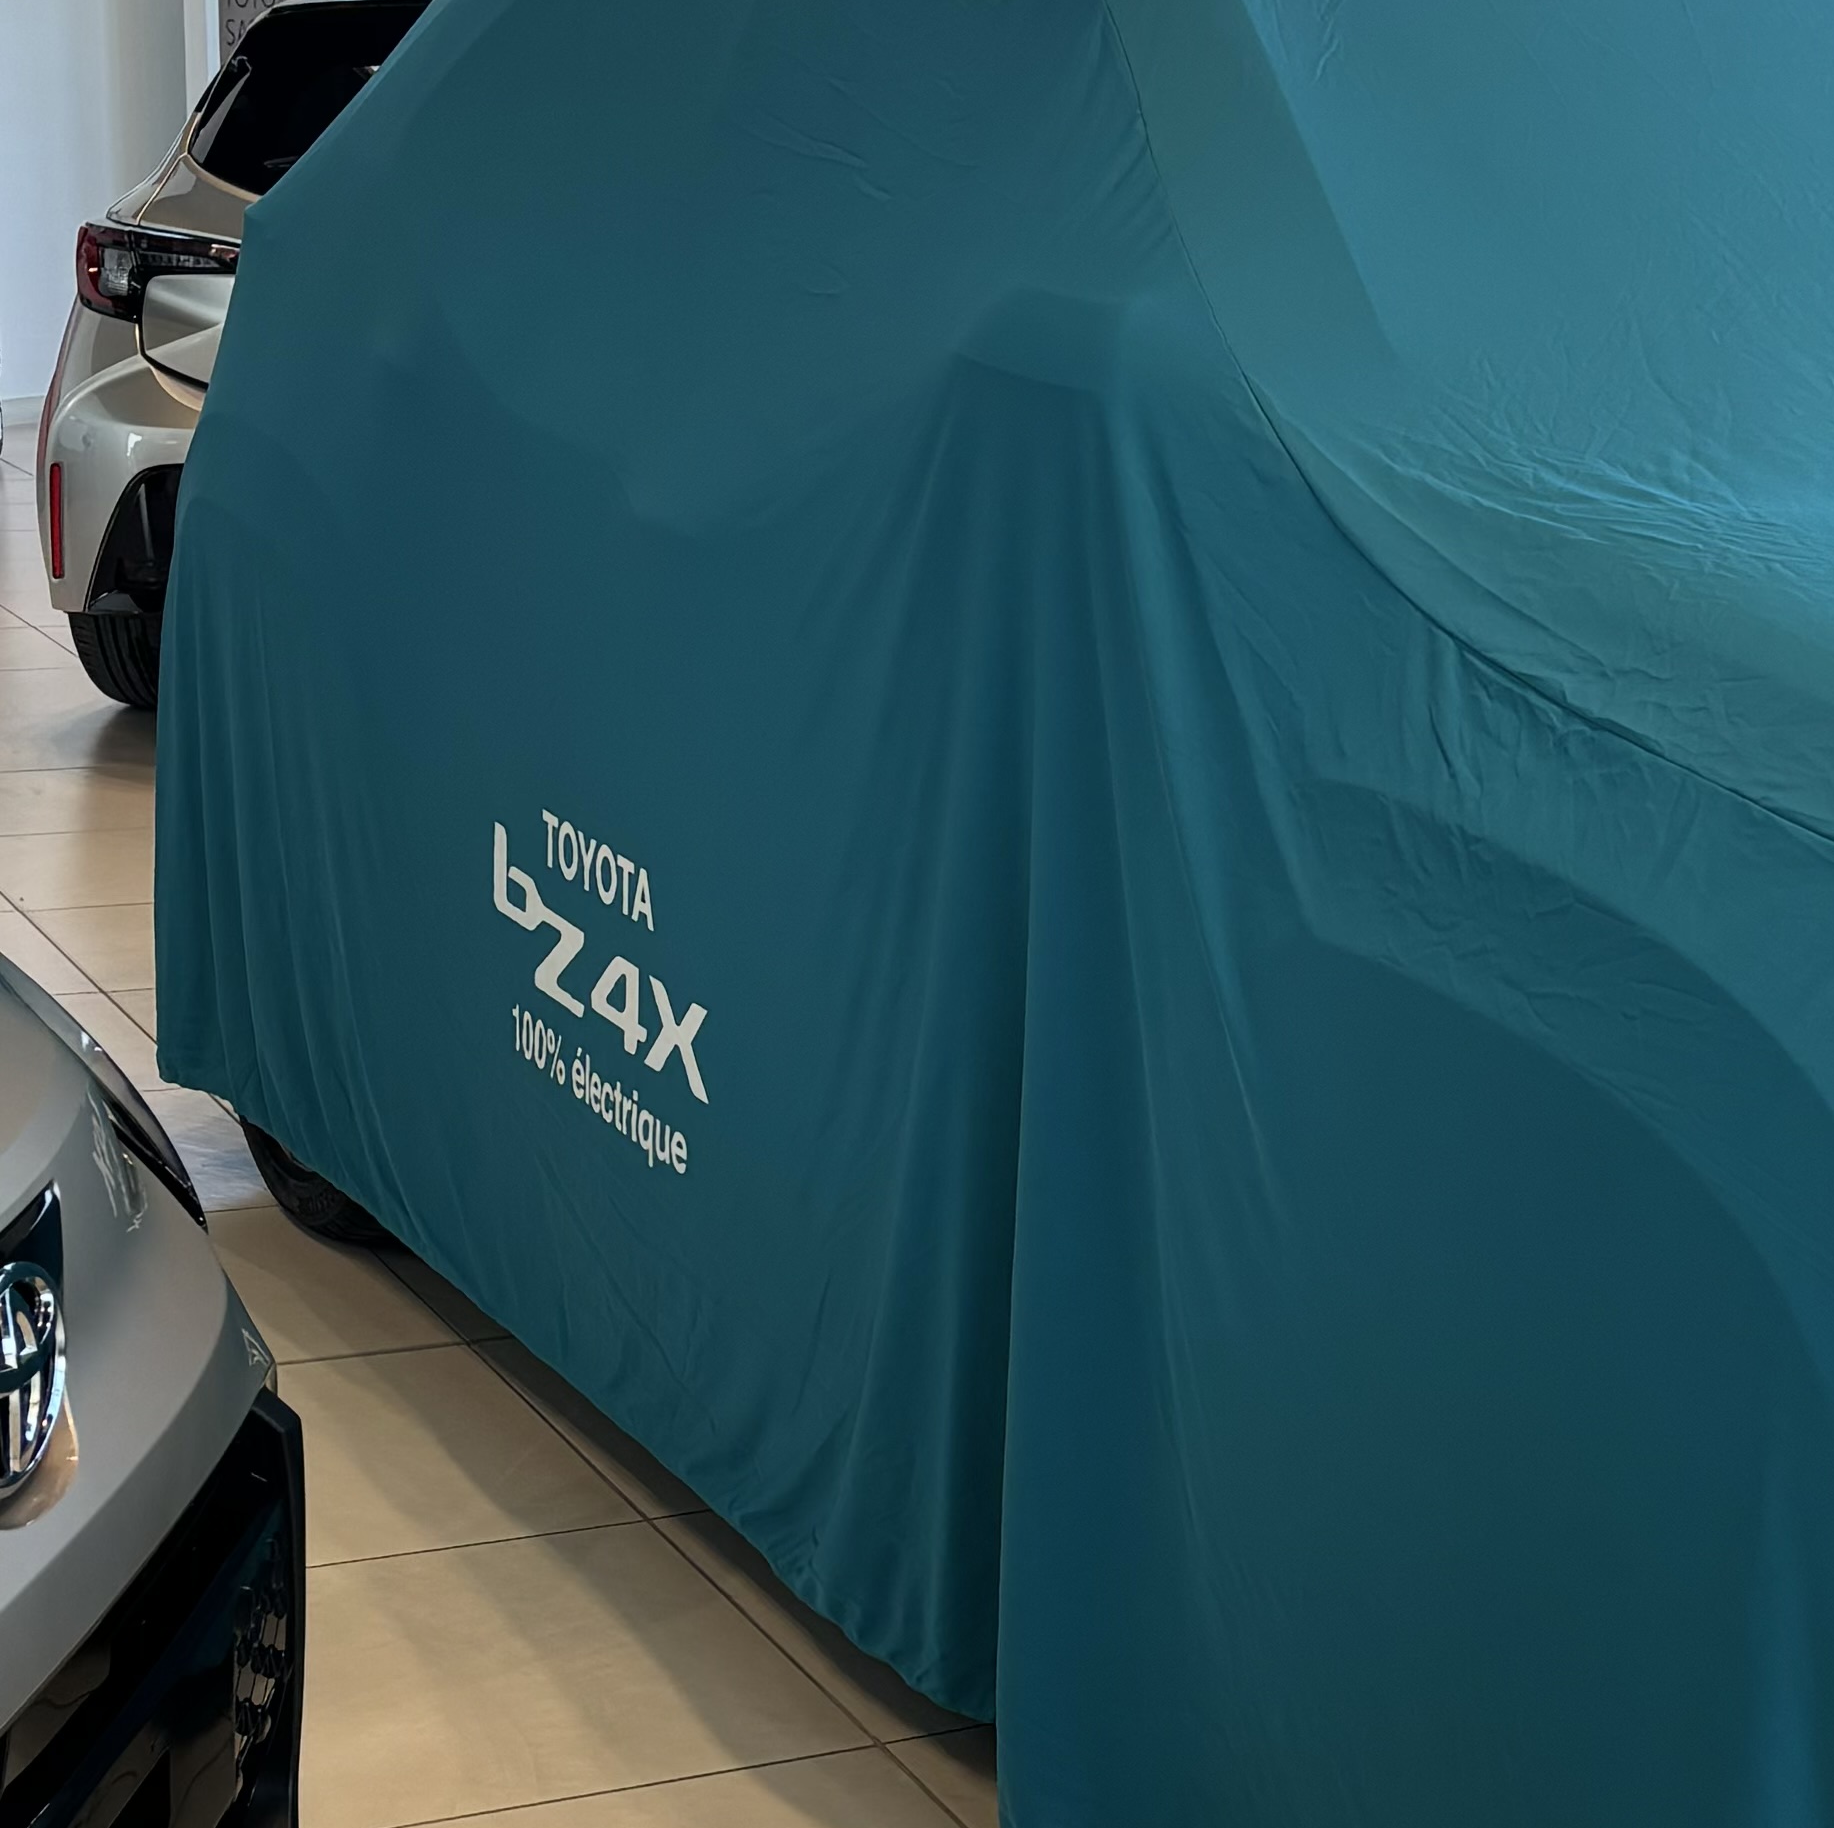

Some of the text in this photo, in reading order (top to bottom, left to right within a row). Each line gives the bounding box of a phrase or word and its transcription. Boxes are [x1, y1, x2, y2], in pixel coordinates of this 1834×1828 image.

[225, 19, 257, 46] SA
[542, 807, 654, 932] TOYOTA
[512, 1003, 688, 1175] 100% électrique
